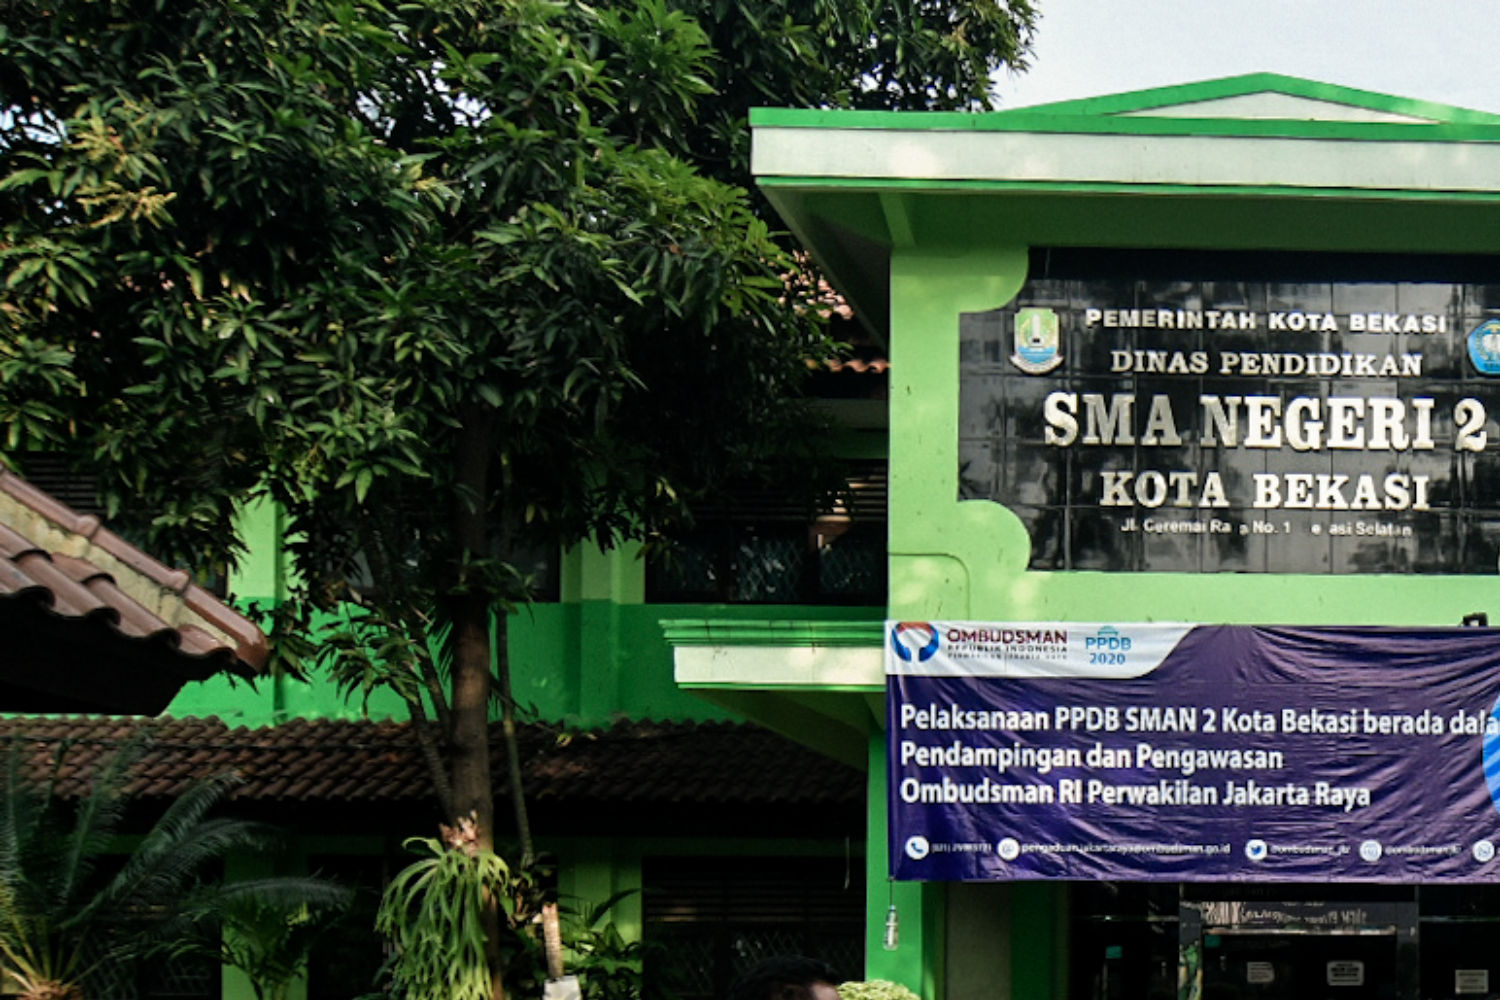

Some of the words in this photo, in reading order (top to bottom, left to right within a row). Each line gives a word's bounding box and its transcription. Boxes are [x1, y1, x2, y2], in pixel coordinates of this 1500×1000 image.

[1085, 308, 1257, 330] PEMERINTAH
[1268, 311, 1340, 332] KOTA
[1349, 313, 1447, 334] BEKASI
[1111, 350, 1210, 375] DINAS
[1219, 352, 1424, 377] PENDIDIKAN
[1044, 391, 1183, 447] SMA
[1200, 395, 1436, 451] NEGERI
[1454, 397, 1488, 451] 2
[1099, 470, 1231, 508] KOTA
[1252, 472, 1431, 511] BEKASI
[1209, 519, 1249, 535] Raa
[946, 629, 1068, 644] OMBUDSMAN
[1085, 637, 1132, 650] PPDB
[1089, 653, 1126, 665] 2020
[901, 703, 1050, 730] Pelaksanaan
[1055, 705, 1120, 732] PPDB
[1125, 707, 1197, 733] SMAN
[1202, 708, 1217, 733] 2
[1222, 707, 1276, 734] Kota
[1281, 708, 1358, 734] Bekasi
[1363, 708, 1444, 735] berada
[901, 740, 1081, 774] Pendampingan
[1086, 742, 1132, 768] dan
[1136, 743, 1283, 775] Pengawasan
[901, 776, 1054, 804] Ombudsman
[1058, 778, 1083, 804] RI
[1088, 778, 1218, 806] Perwakilan
[1222, 779, 1310, 806] Jakarta
[1315, 781, 1371, 813] Raya
